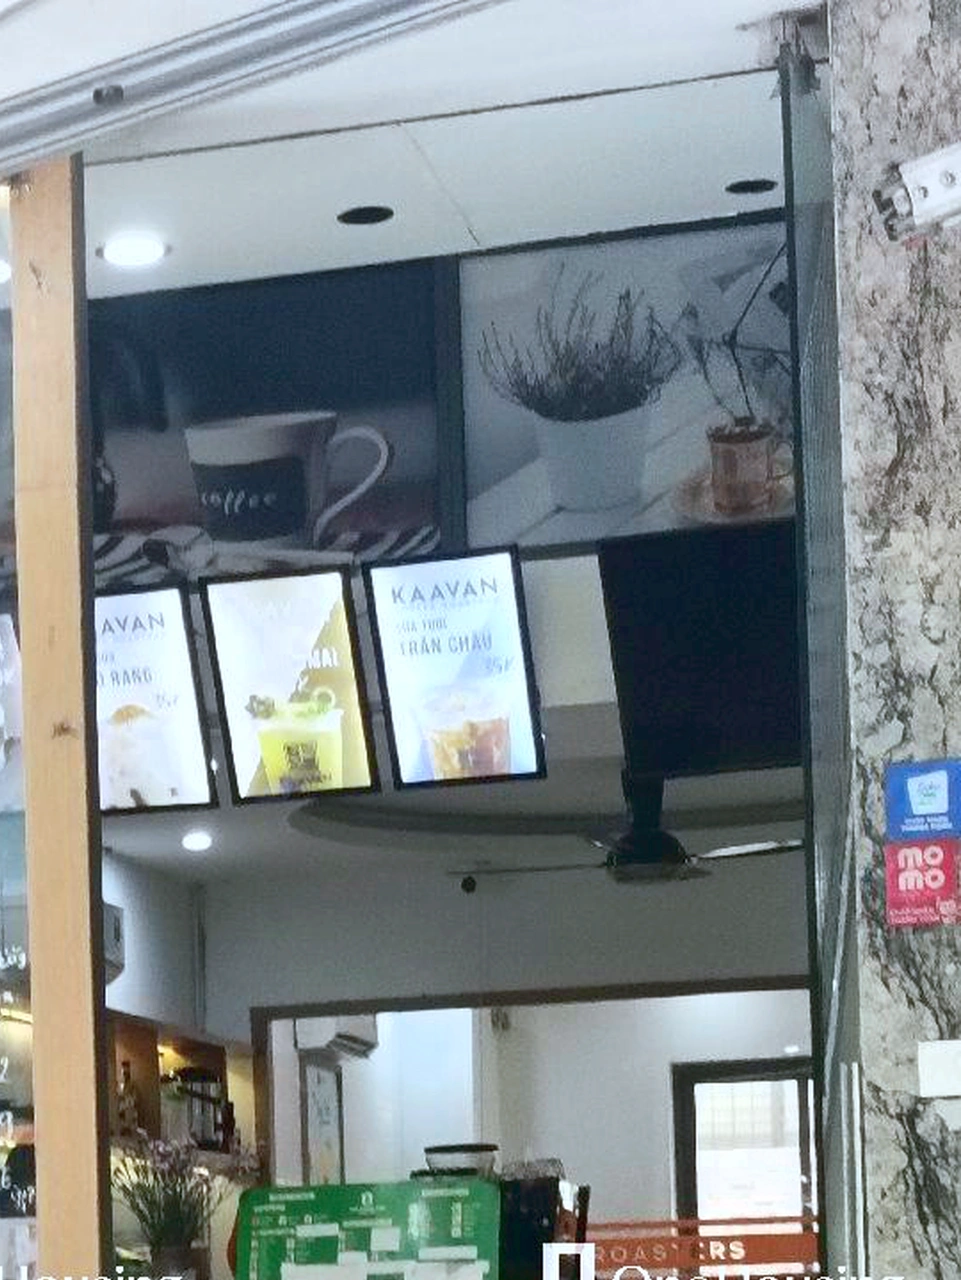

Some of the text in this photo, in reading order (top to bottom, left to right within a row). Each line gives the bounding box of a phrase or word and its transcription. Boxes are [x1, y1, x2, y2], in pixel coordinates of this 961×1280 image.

[391, 577, 499, 604] KAAVAN
[101, 611, 165, 635] AVAN
[596, 1241, 746, 1262] ROASRS
